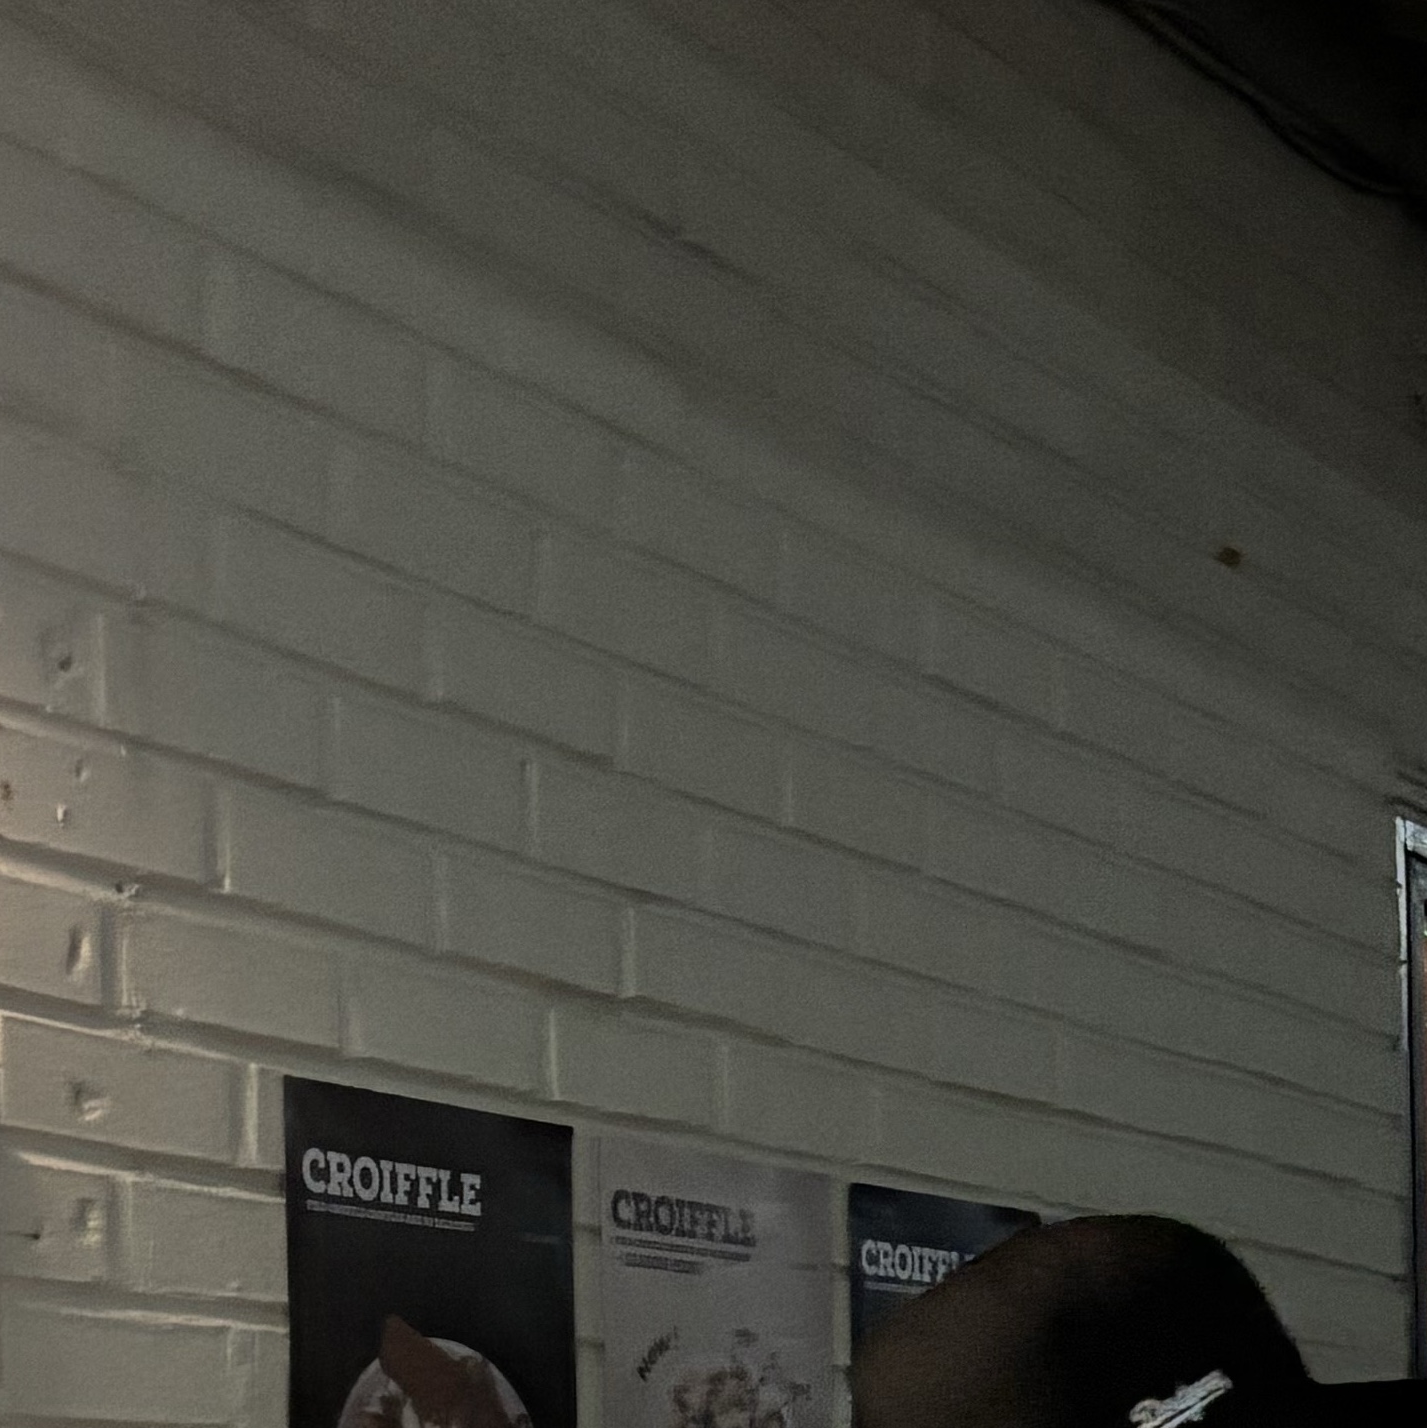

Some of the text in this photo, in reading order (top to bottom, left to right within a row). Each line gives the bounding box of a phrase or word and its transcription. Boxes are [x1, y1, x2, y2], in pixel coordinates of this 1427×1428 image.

[302, 1147, 482, 1217] CROIFFLE
[611, 1189, 757, 1247] CROIFFLE
[861, 1239, 976, 1284] CROIFF
